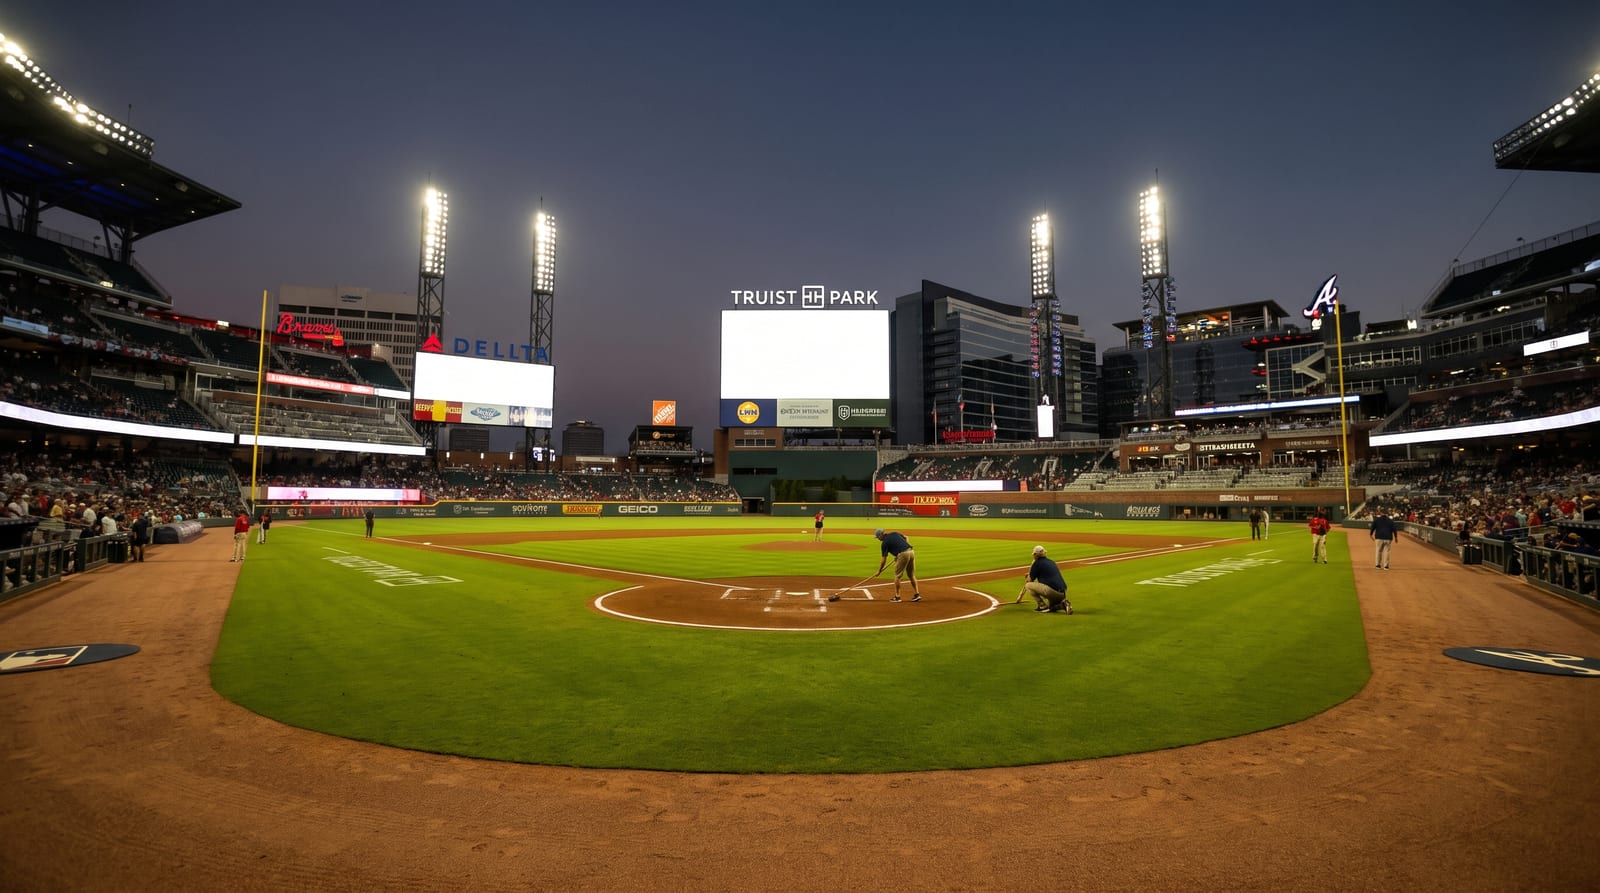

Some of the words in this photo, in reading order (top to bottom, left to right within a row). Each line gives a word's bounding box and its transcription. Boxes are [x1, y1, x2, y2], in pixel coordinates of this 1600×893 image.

[730, 290, 797, 305] TRUIST
[830, 290, 878, 305] PARK
[277, 312, 335, 334] Braves
[618, 505, 658, 514] GEICO
